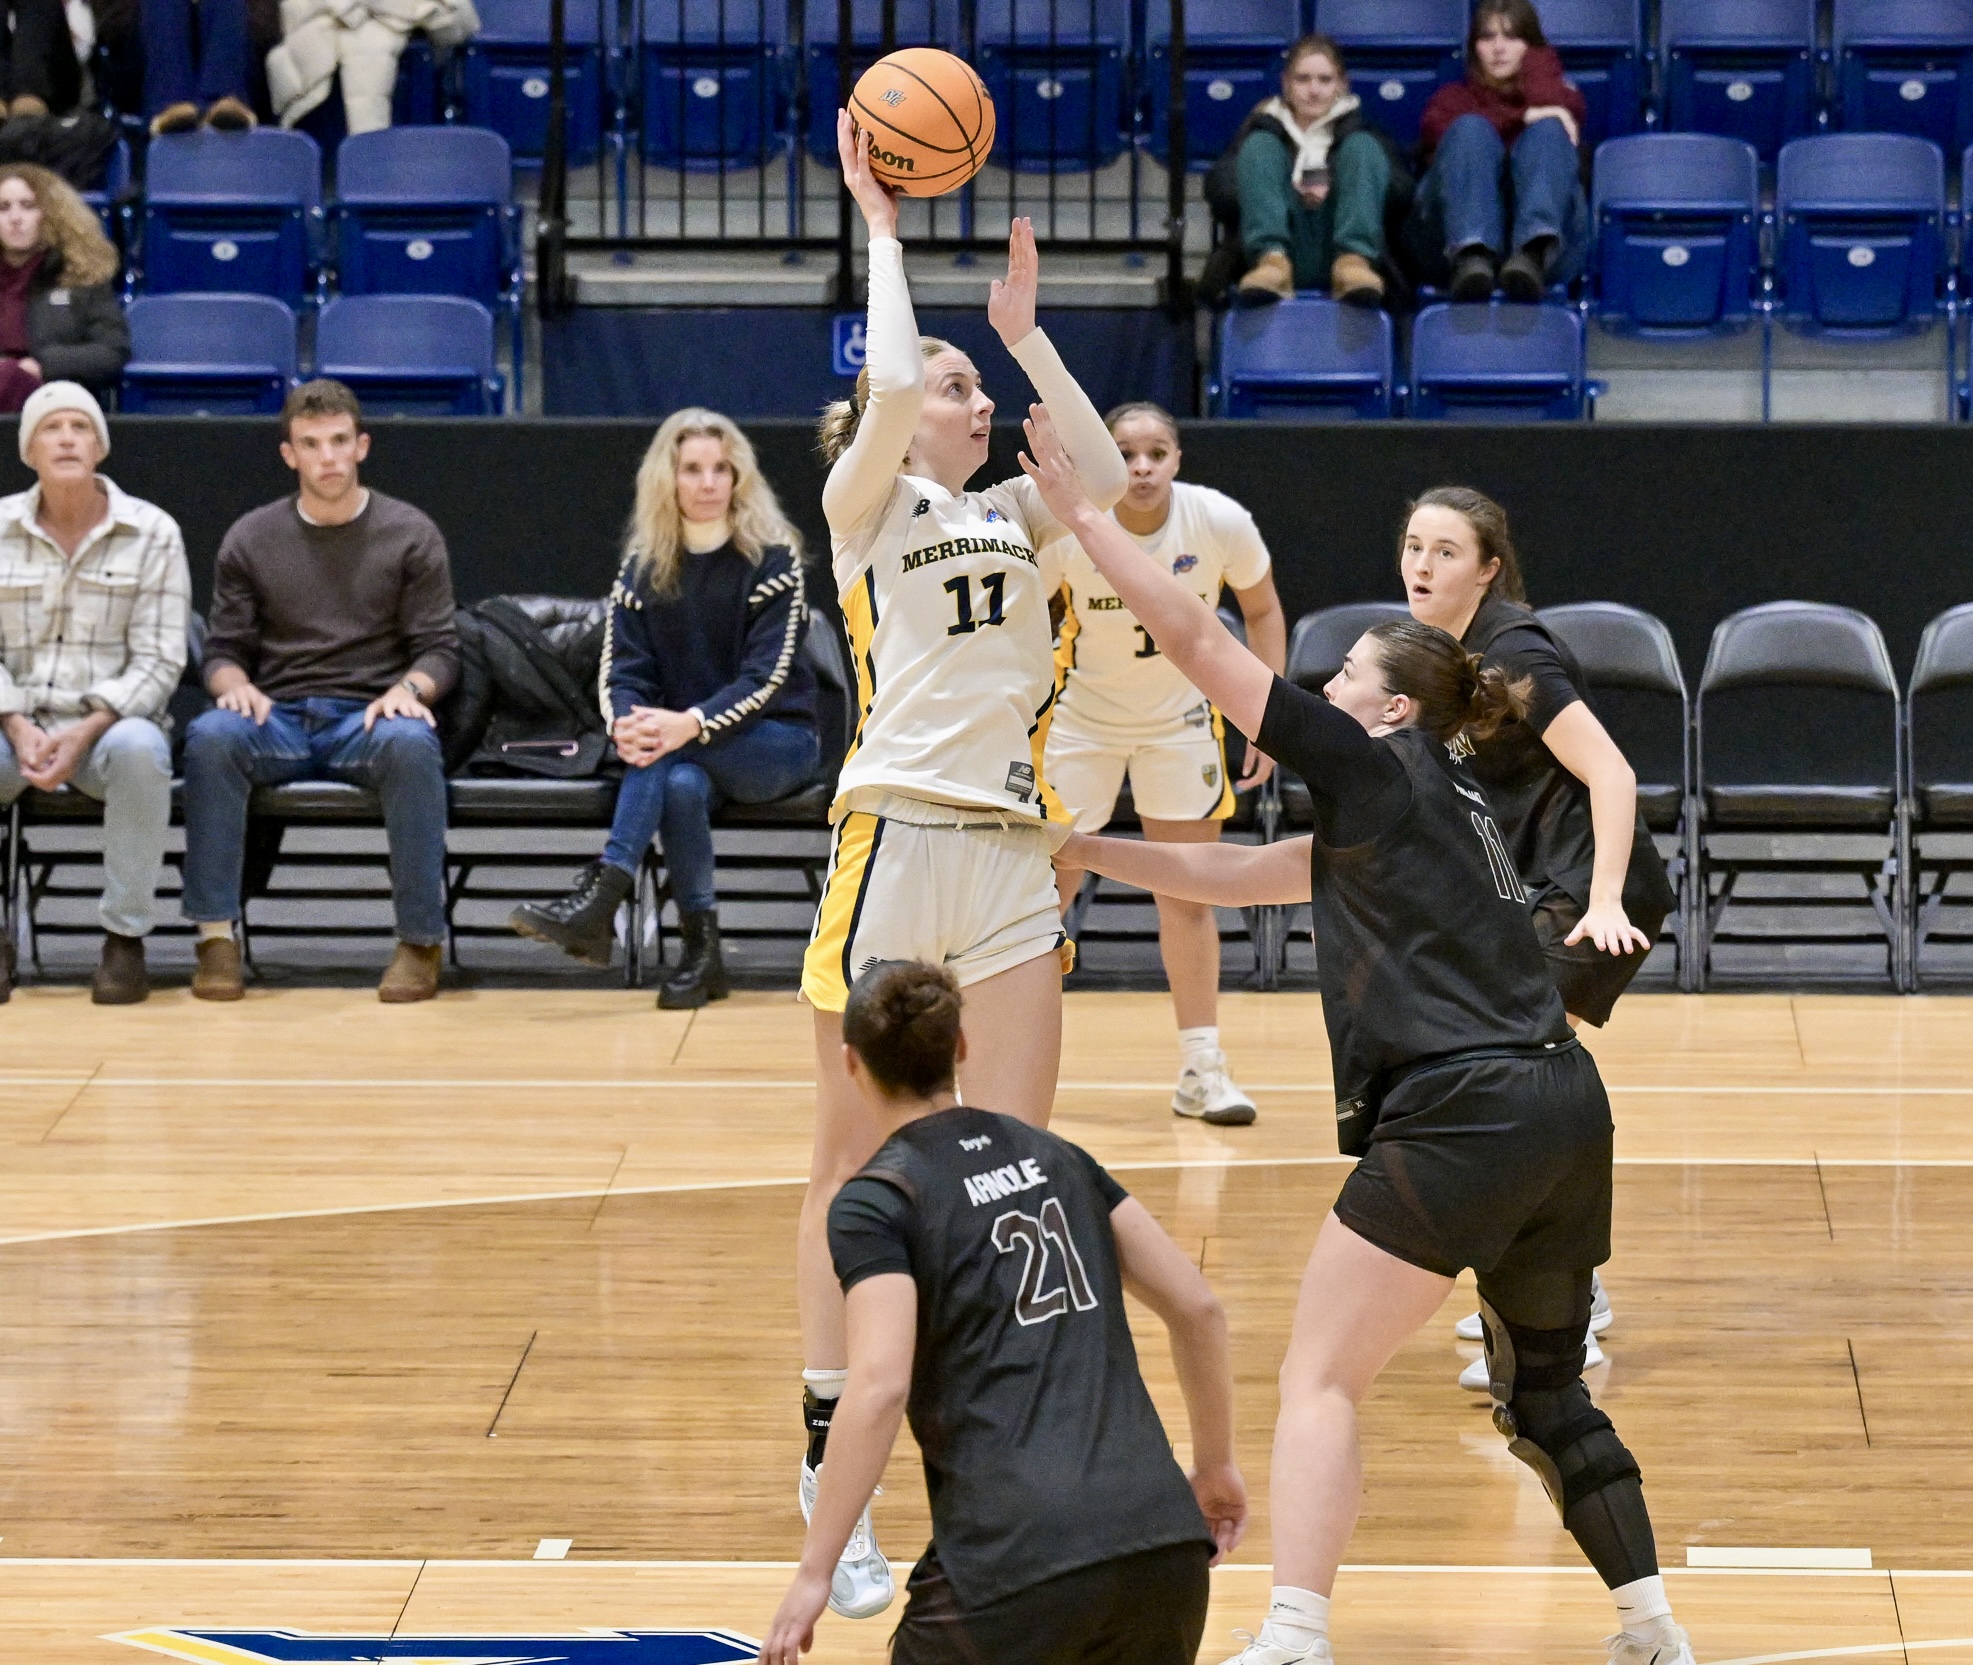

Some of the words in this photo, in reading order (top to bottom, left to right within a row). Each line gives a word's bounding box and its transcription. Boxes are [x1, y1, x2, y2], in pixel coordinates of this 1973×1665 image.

[902, 537, 1038, 574] MERRIMACK
[943, 572, 1006, 636] 11
[1471, 811, 1526, 904] 11
[991, 1197, 1098, 1327] 21
